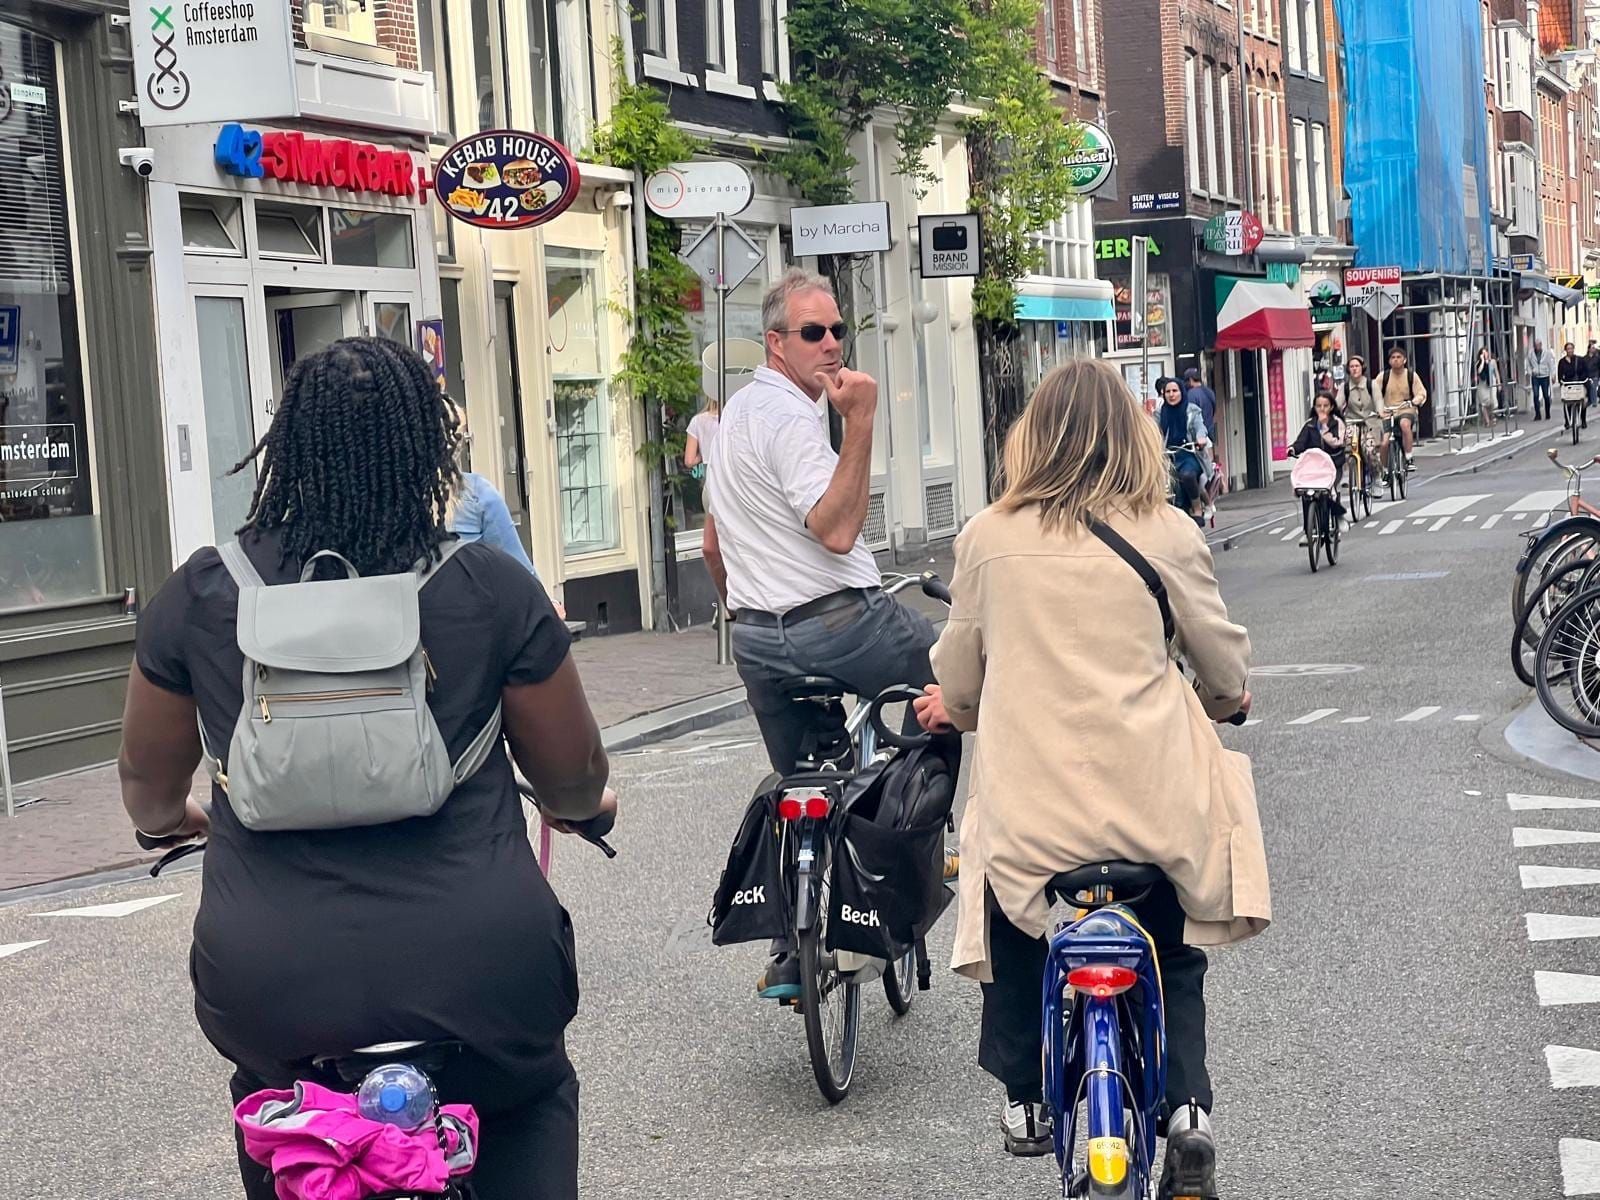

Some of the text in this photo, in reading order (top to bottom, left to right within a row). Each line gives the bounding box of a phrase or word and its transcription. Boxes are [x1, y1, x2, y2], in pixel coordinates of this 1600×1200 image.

[184, 0, 254, 22] Coffeeshop
[186, 24, 258, 46] Amsterdam
[264, 131, 415, 196] SNACKBAR
[442, 137, 561, 179] KEBAB HOUSE
[687, 184, 748, 194] sieraden
[488, 197, 520, 222] 42
[799, 220, 881, 240] by Marcha
[1215, 215, 1252, 227] PIZZA
[932, 252, 969, 263] BRAND
[932, 262, 969, 272] MISSION
[1346, 268, 1399, 281] SOUVENIRS
[265, 398, 274, 416] 42
[0, 436, 70, 461] msterdam
[0, 488, 39, 499] msterdam
